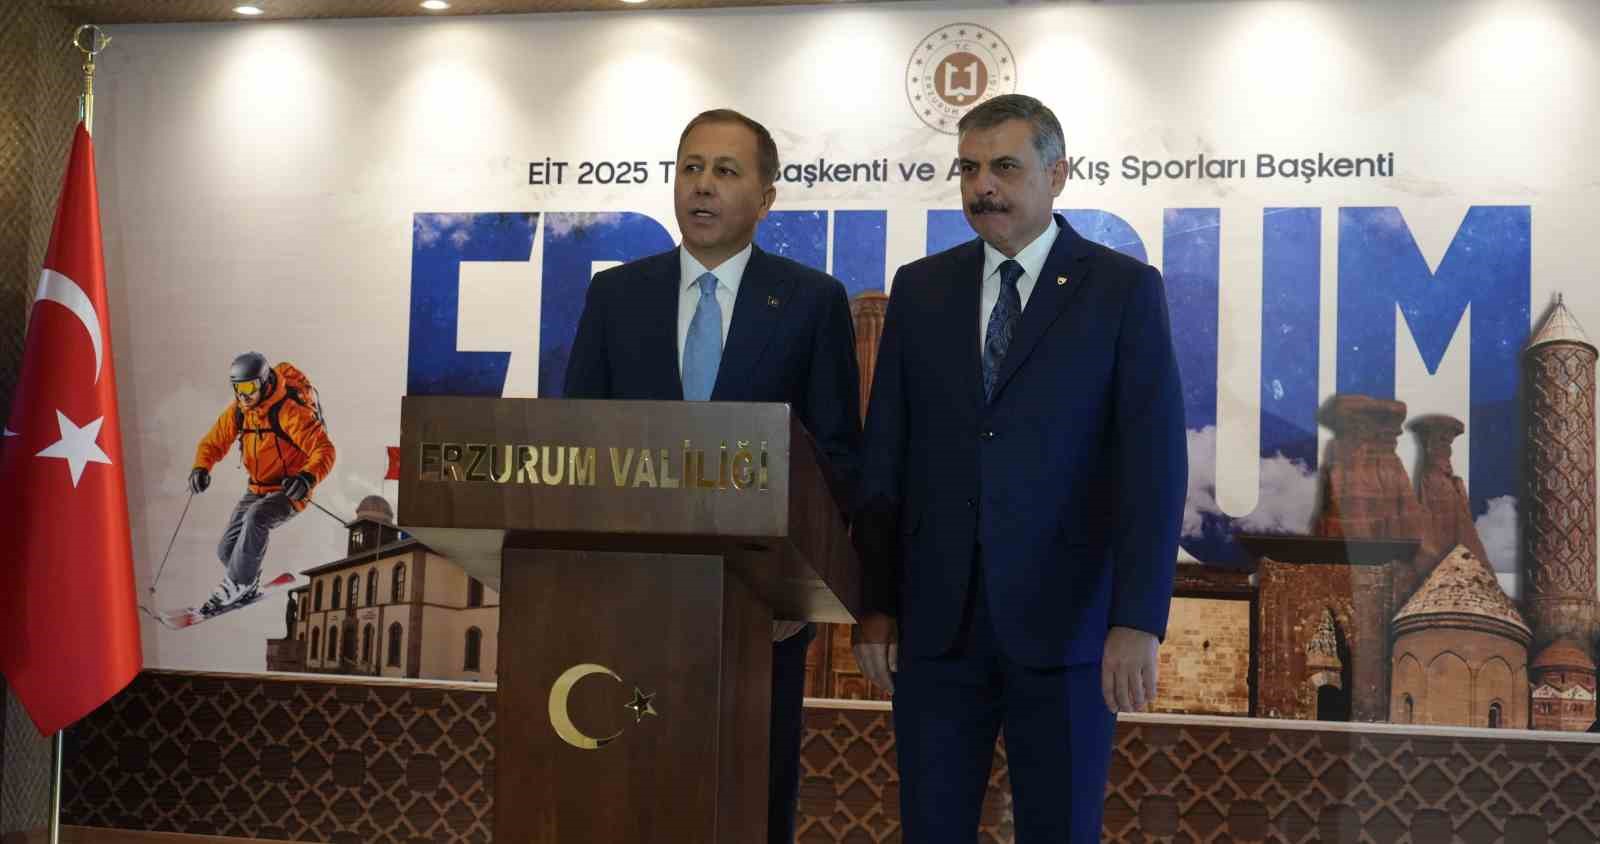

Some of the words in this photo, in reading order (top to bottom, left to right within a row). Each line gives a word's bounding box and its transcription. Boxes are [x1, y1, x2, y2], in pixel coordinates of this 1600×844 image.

[528, 157, 568, 185] EİT
[577, 161, 649, 185] 2025
[775, 157, 888, 188] aşkenti
[898, 162, 936, 182] ve
[1068, 155, 1110, 186] Kış
[1121, 153, 1246, 186] Sporları
[1256, 152, 1395, 184] Başkenti
[418, 442, 597, 487] ERZURUM
[608, 440, 770, 494] VALİLİĞİ
